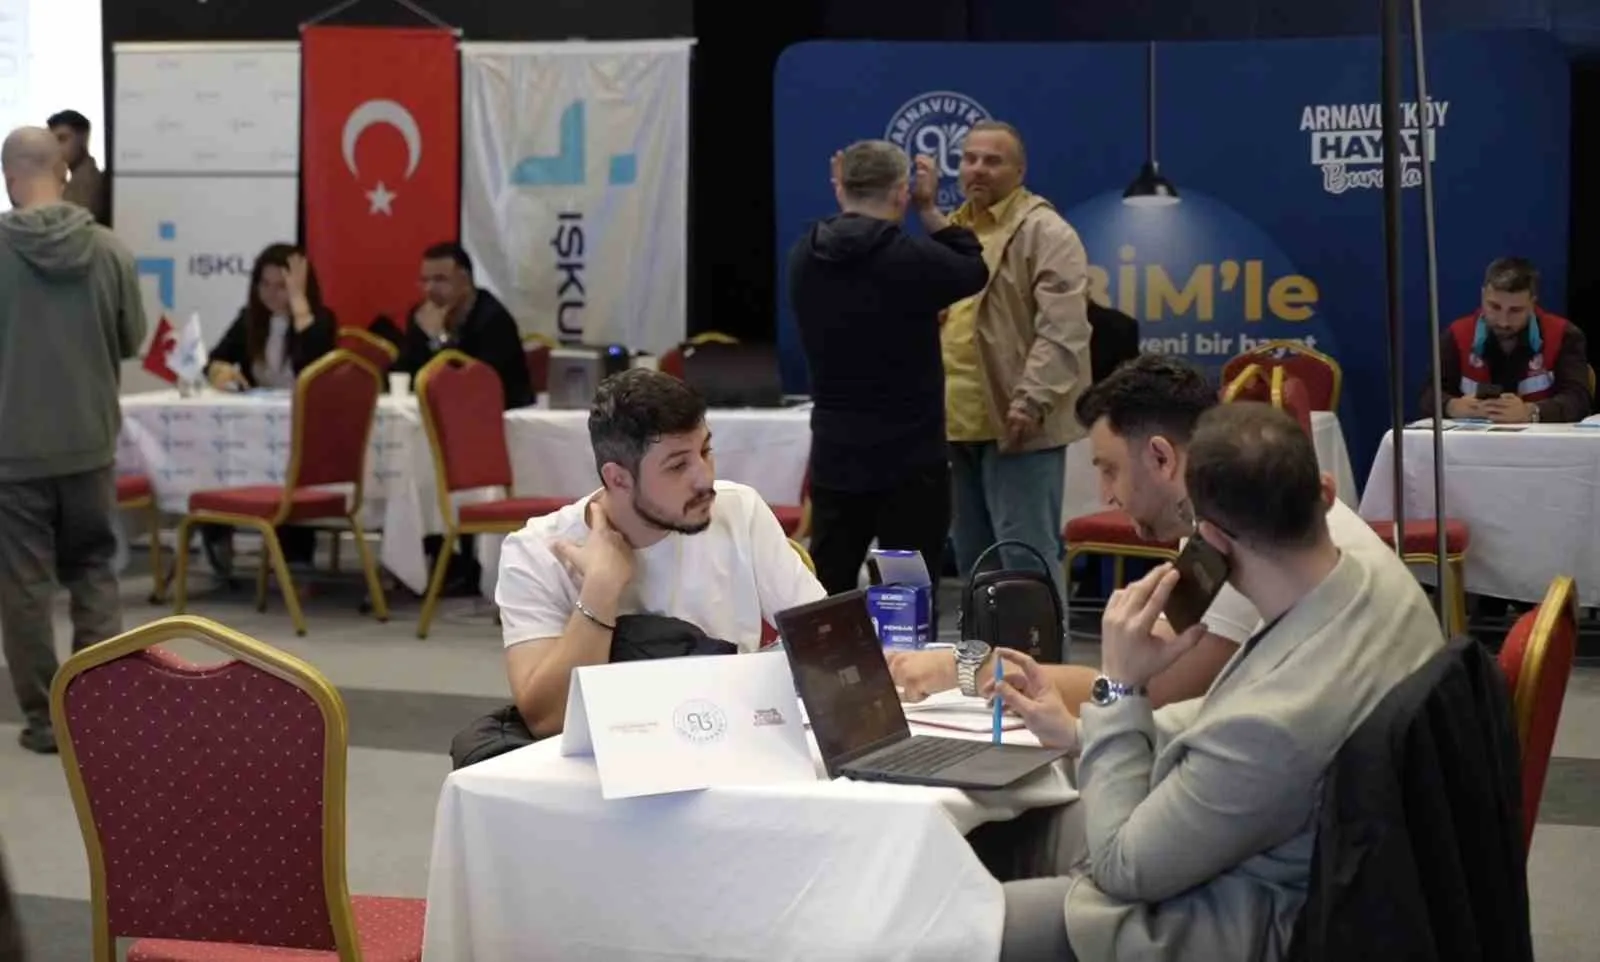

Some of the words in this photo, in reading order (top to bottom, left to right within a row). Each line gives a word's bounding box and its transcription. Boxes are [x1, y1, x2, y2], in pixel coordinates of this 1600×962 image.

[891, 98, 985, 144] ARNAVUTK
[1300, 97, 1449, 131] ARNAVKÖY
[1195, 332, 1232, 355] bir
